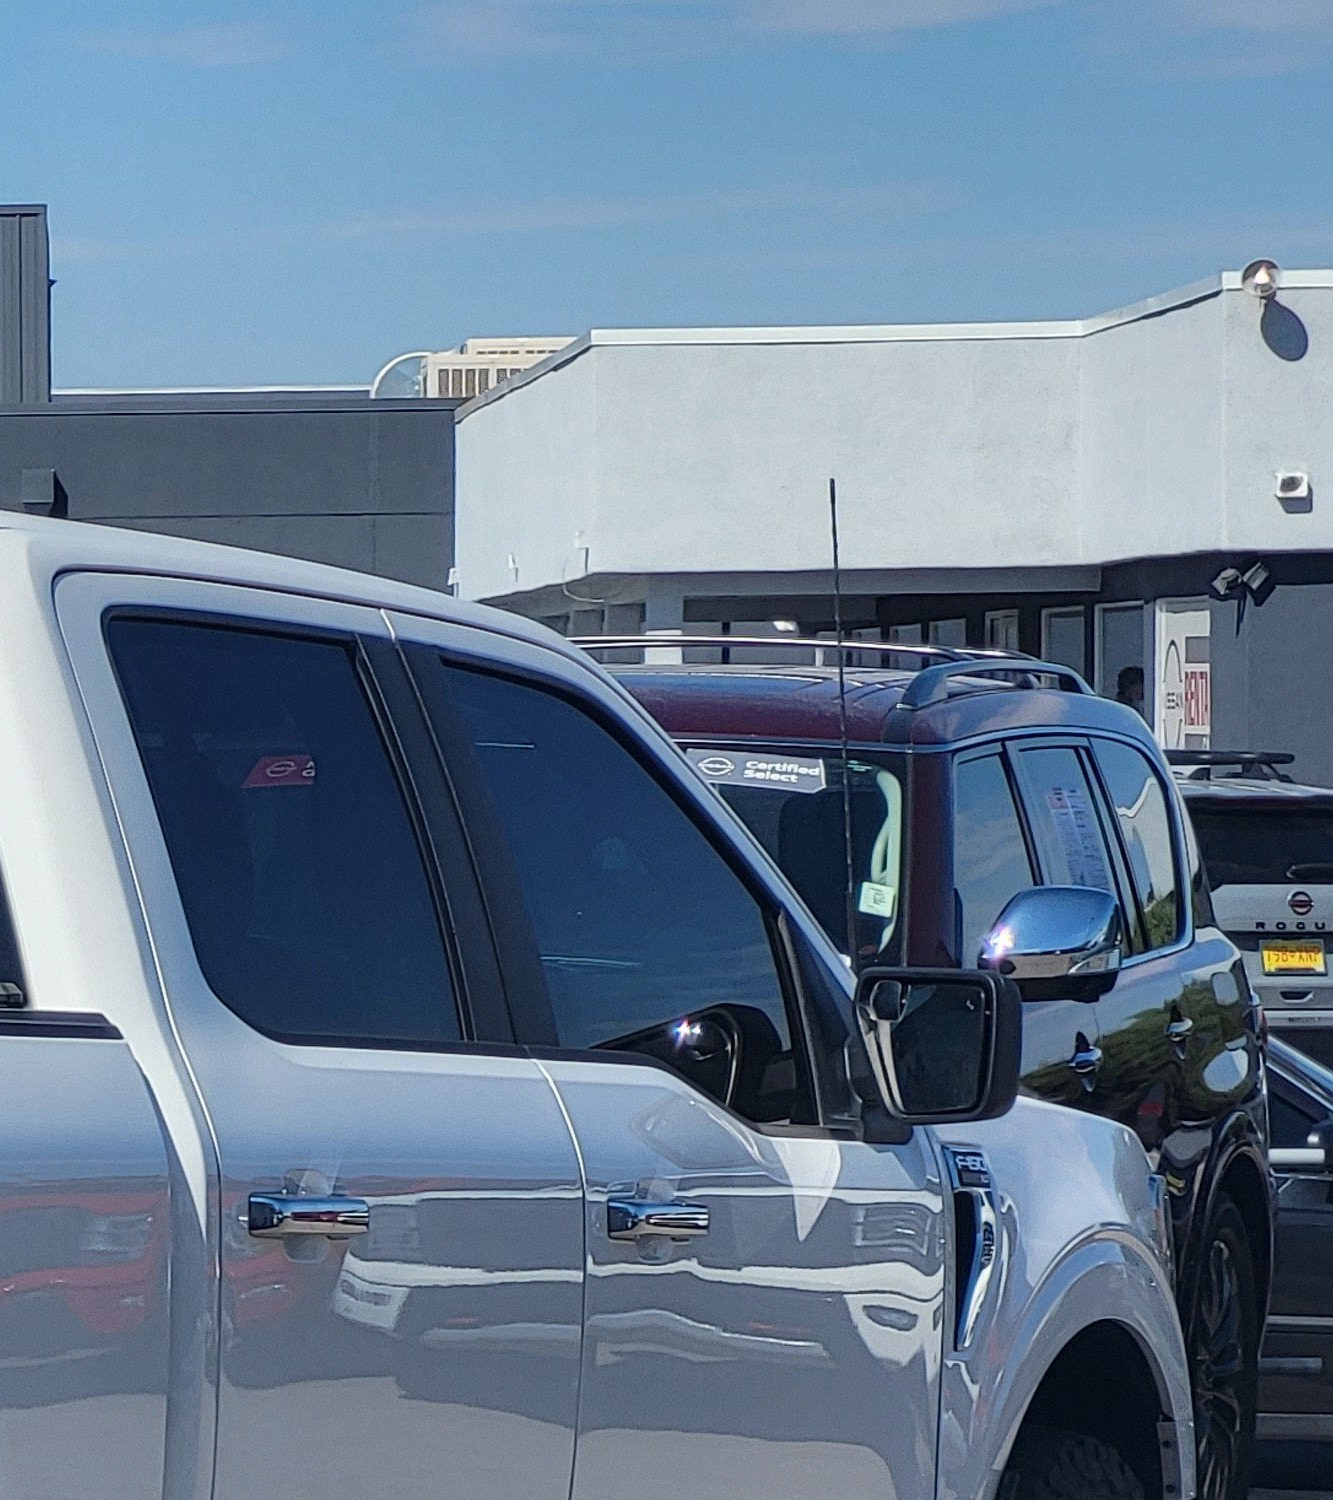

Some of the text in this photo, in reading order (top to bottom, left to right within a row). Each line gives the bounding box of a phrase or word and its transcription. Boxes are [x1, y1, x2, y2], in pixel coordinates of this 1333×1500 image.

[745, 760, 820, 777] Certified
[743, 769, 799, 783] Select
[1255, 921, 1326, 930] ROGU
